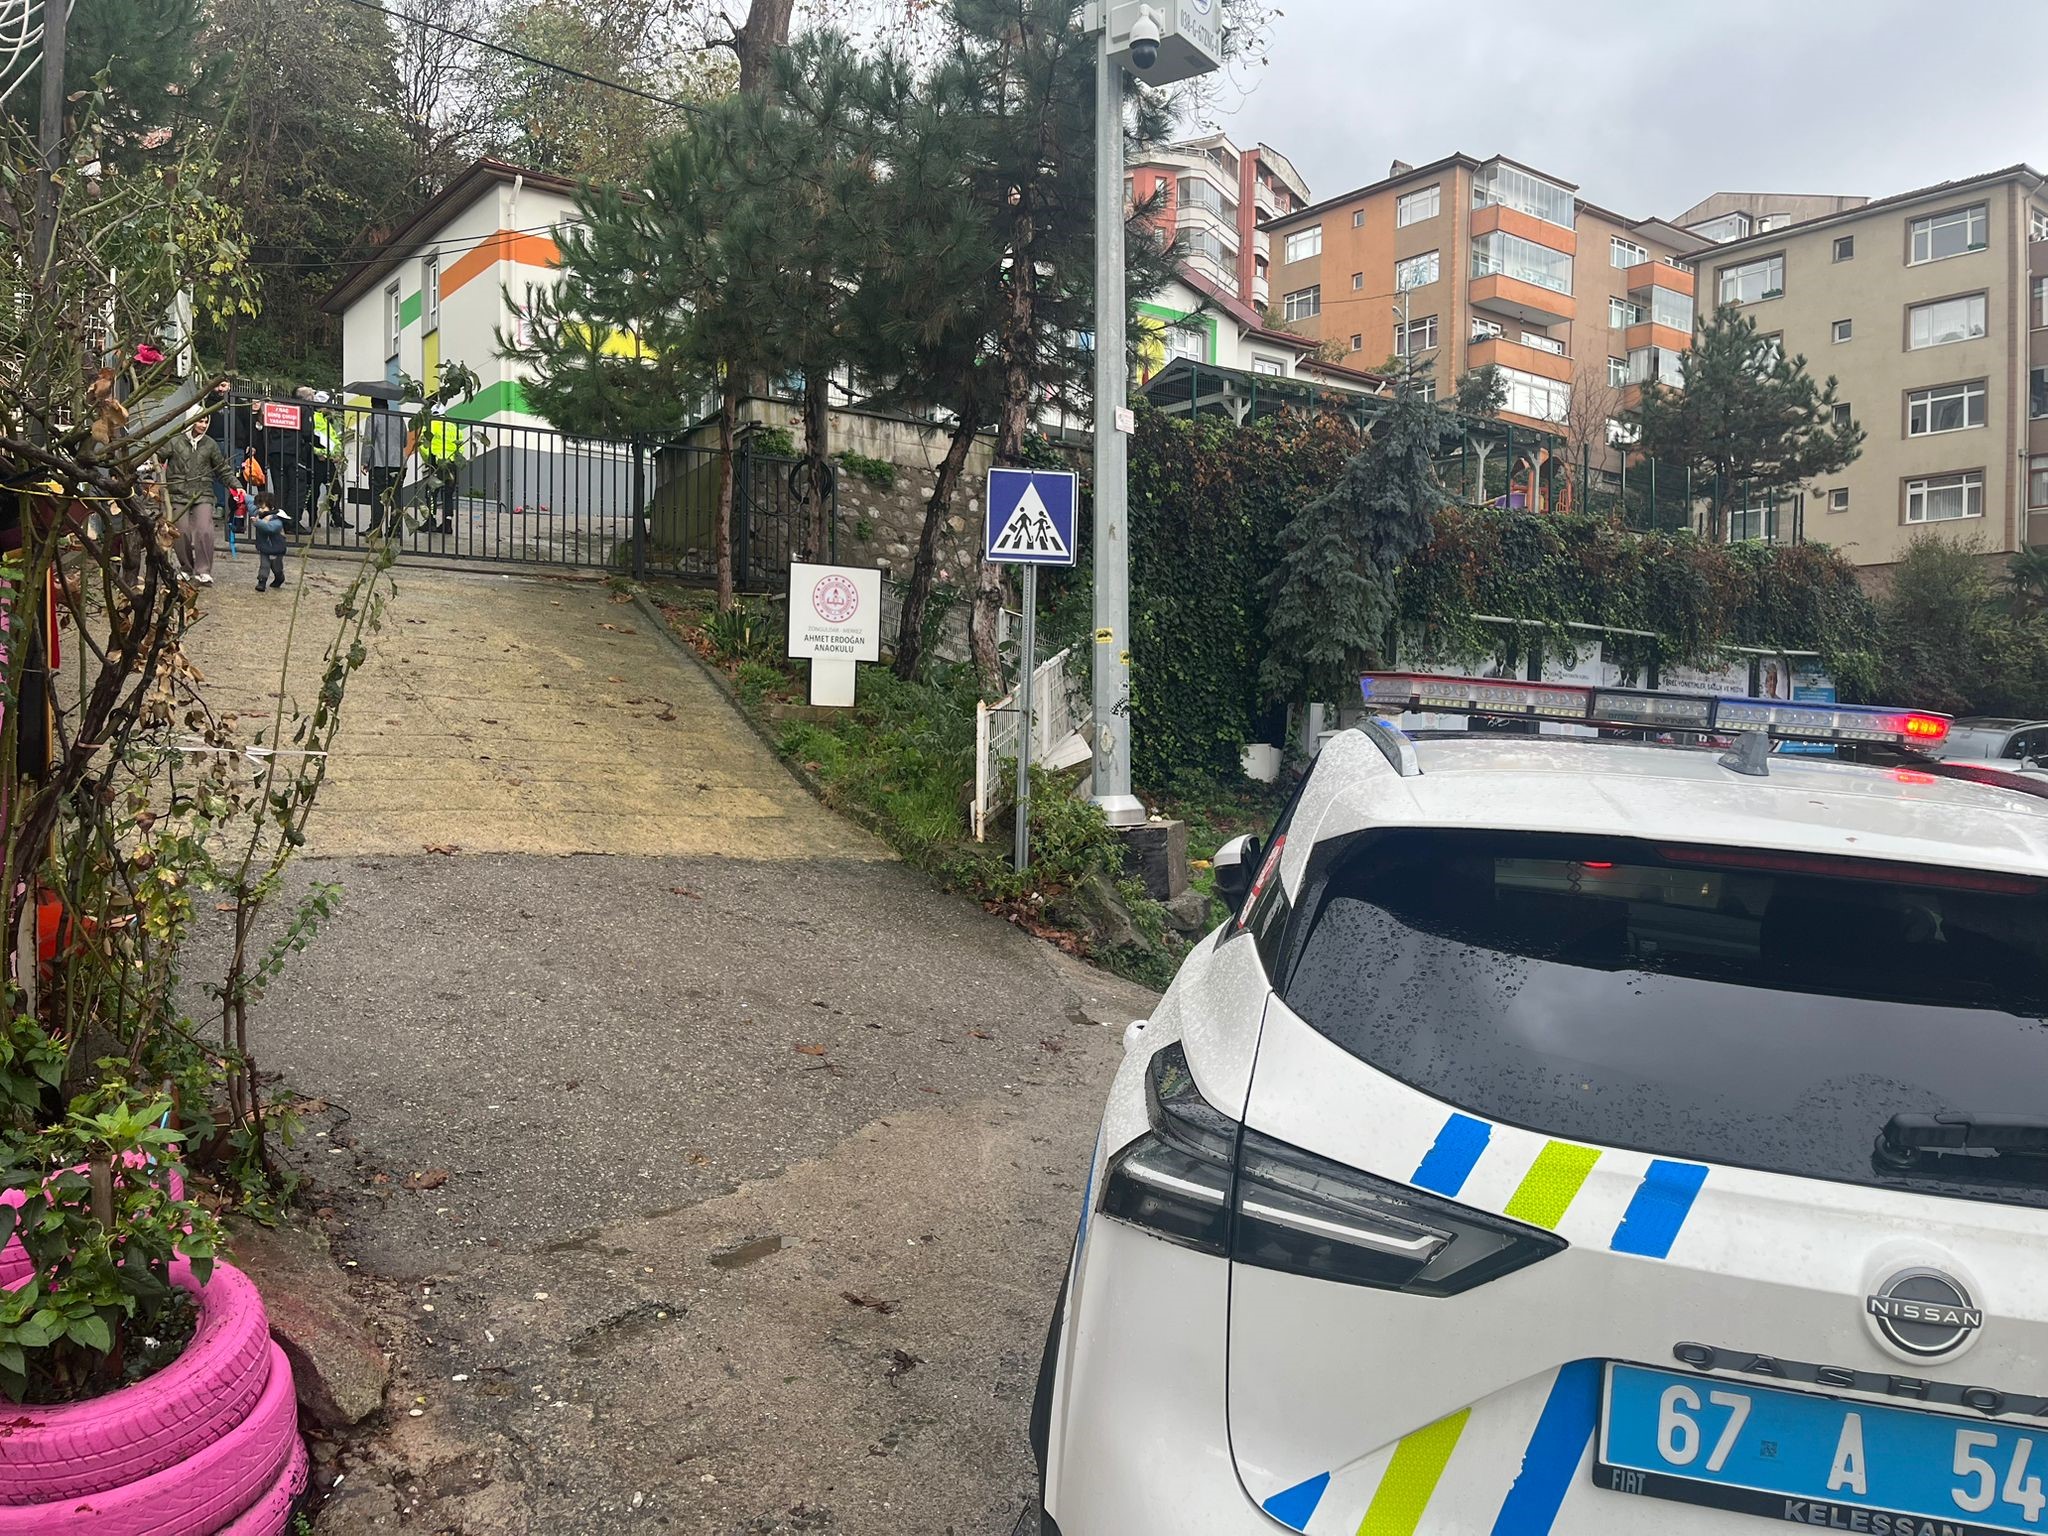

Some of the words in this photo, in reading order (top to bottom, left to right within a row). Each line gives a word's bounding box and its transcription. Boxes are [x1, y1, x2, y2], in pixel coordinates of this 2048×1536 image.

[804, 634, 829, 643] AHMET
[830, 635, 865, 644] ERDOĞAN
[814, 644, 854, 653] ANAOKULU
[1871, 1299, 1980, 1326] NISSAN
[1672, 1340, 2048, 1418] QASHQ
[1656, 1384, 1752, 1473] 67
[1826, 1412, 1868, 1496] A
[1950, 1428, 2047, 1523] 54
[1611, 1469, 1646, 1495] FIAT
